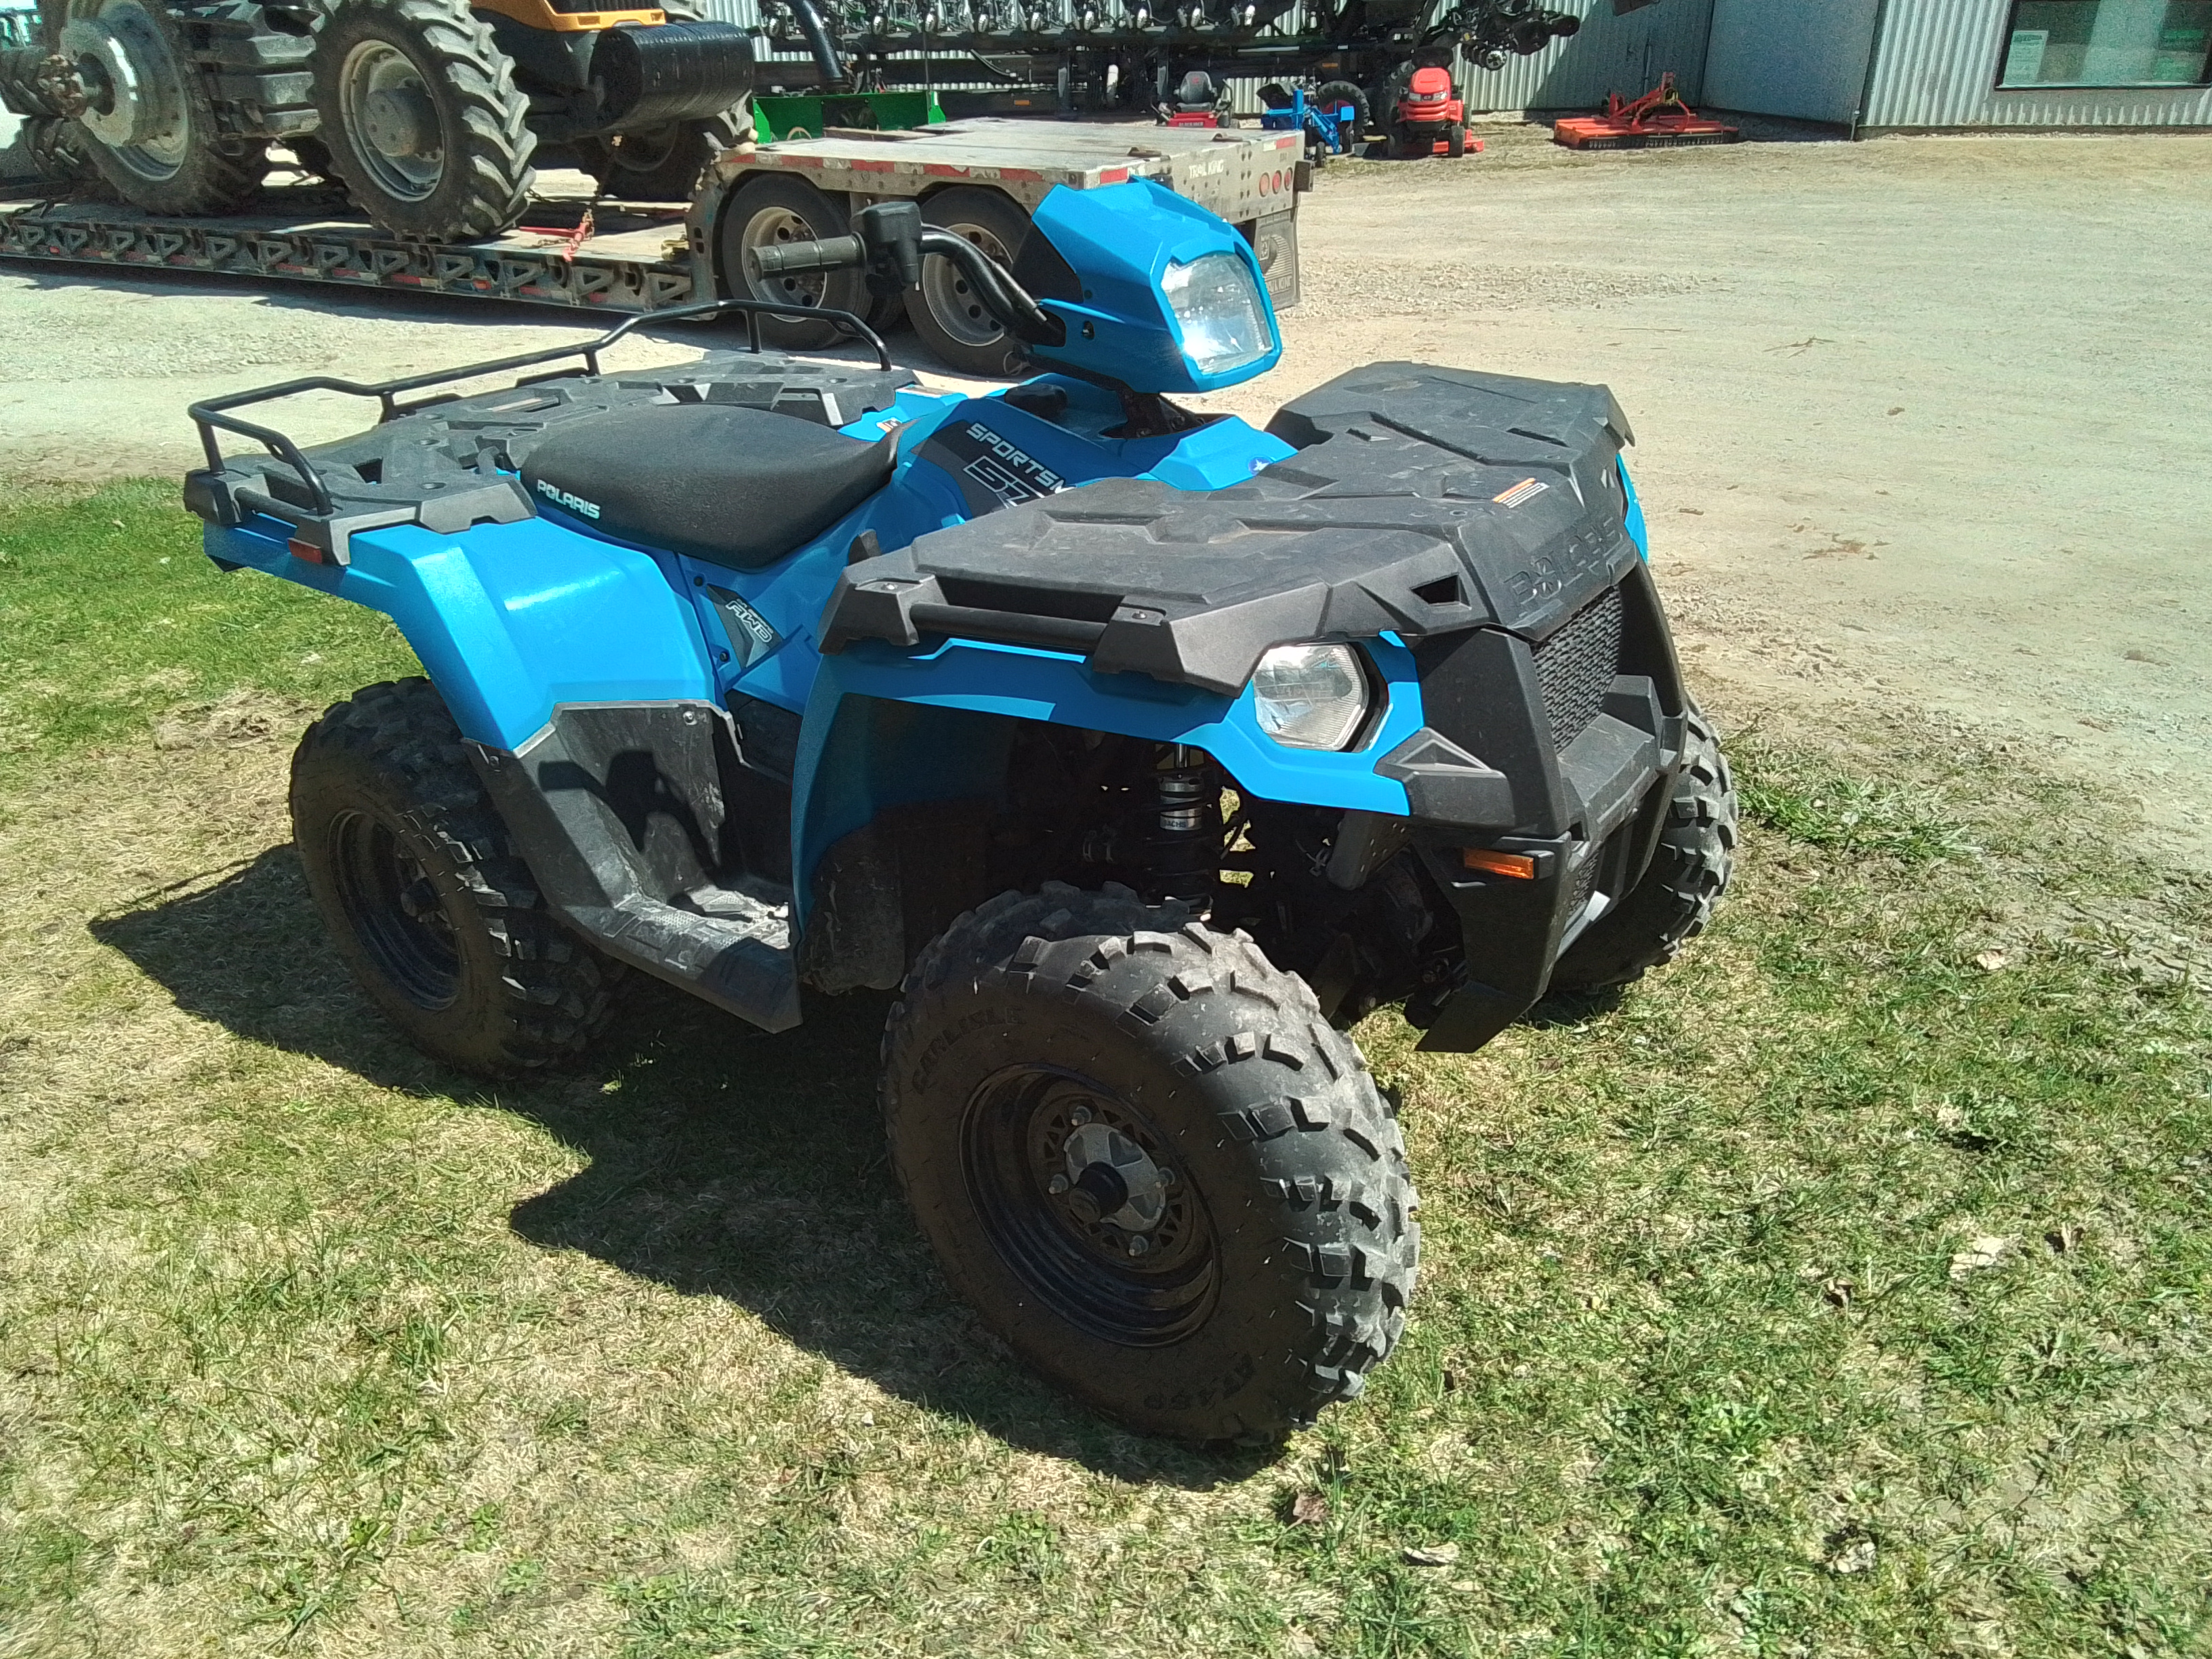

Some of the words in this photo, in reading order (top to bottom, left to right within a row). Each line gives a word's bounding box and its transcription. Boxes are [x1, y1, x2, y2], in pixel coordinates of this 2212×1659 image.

[1189, 162, 1207, 179] TRAIL
[1208, 159, 1224, 175] KING
[537, 478, 600, 519] POLARIS
[725, 600, 773, 642] AWD
